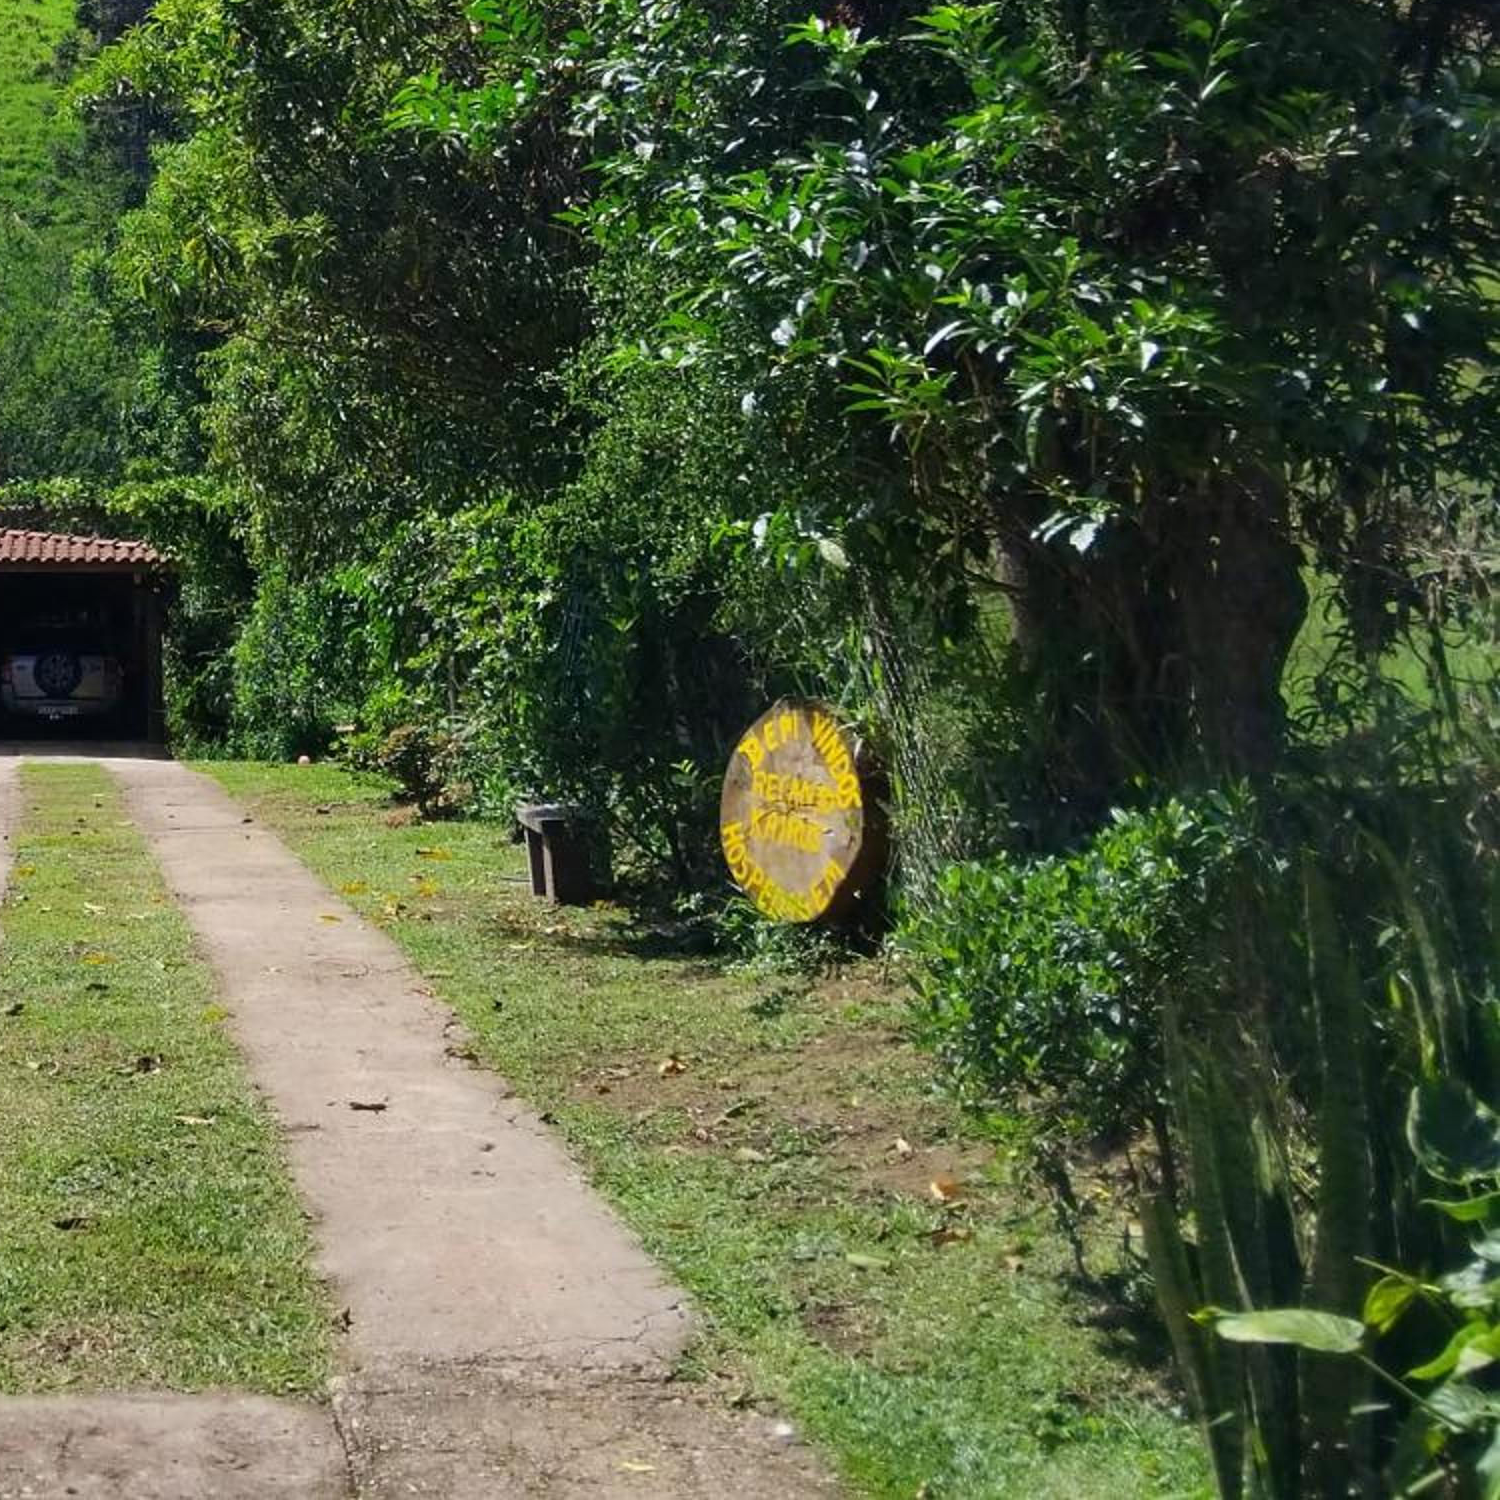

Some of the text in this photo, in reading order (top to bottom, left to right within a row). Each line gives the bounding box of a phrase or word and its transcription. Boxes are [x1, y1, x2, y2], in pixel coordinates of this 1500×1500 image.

[738, 709, 863, 810] BEM VINDOS
[721, 819, 847, 922] HOSPEEM
